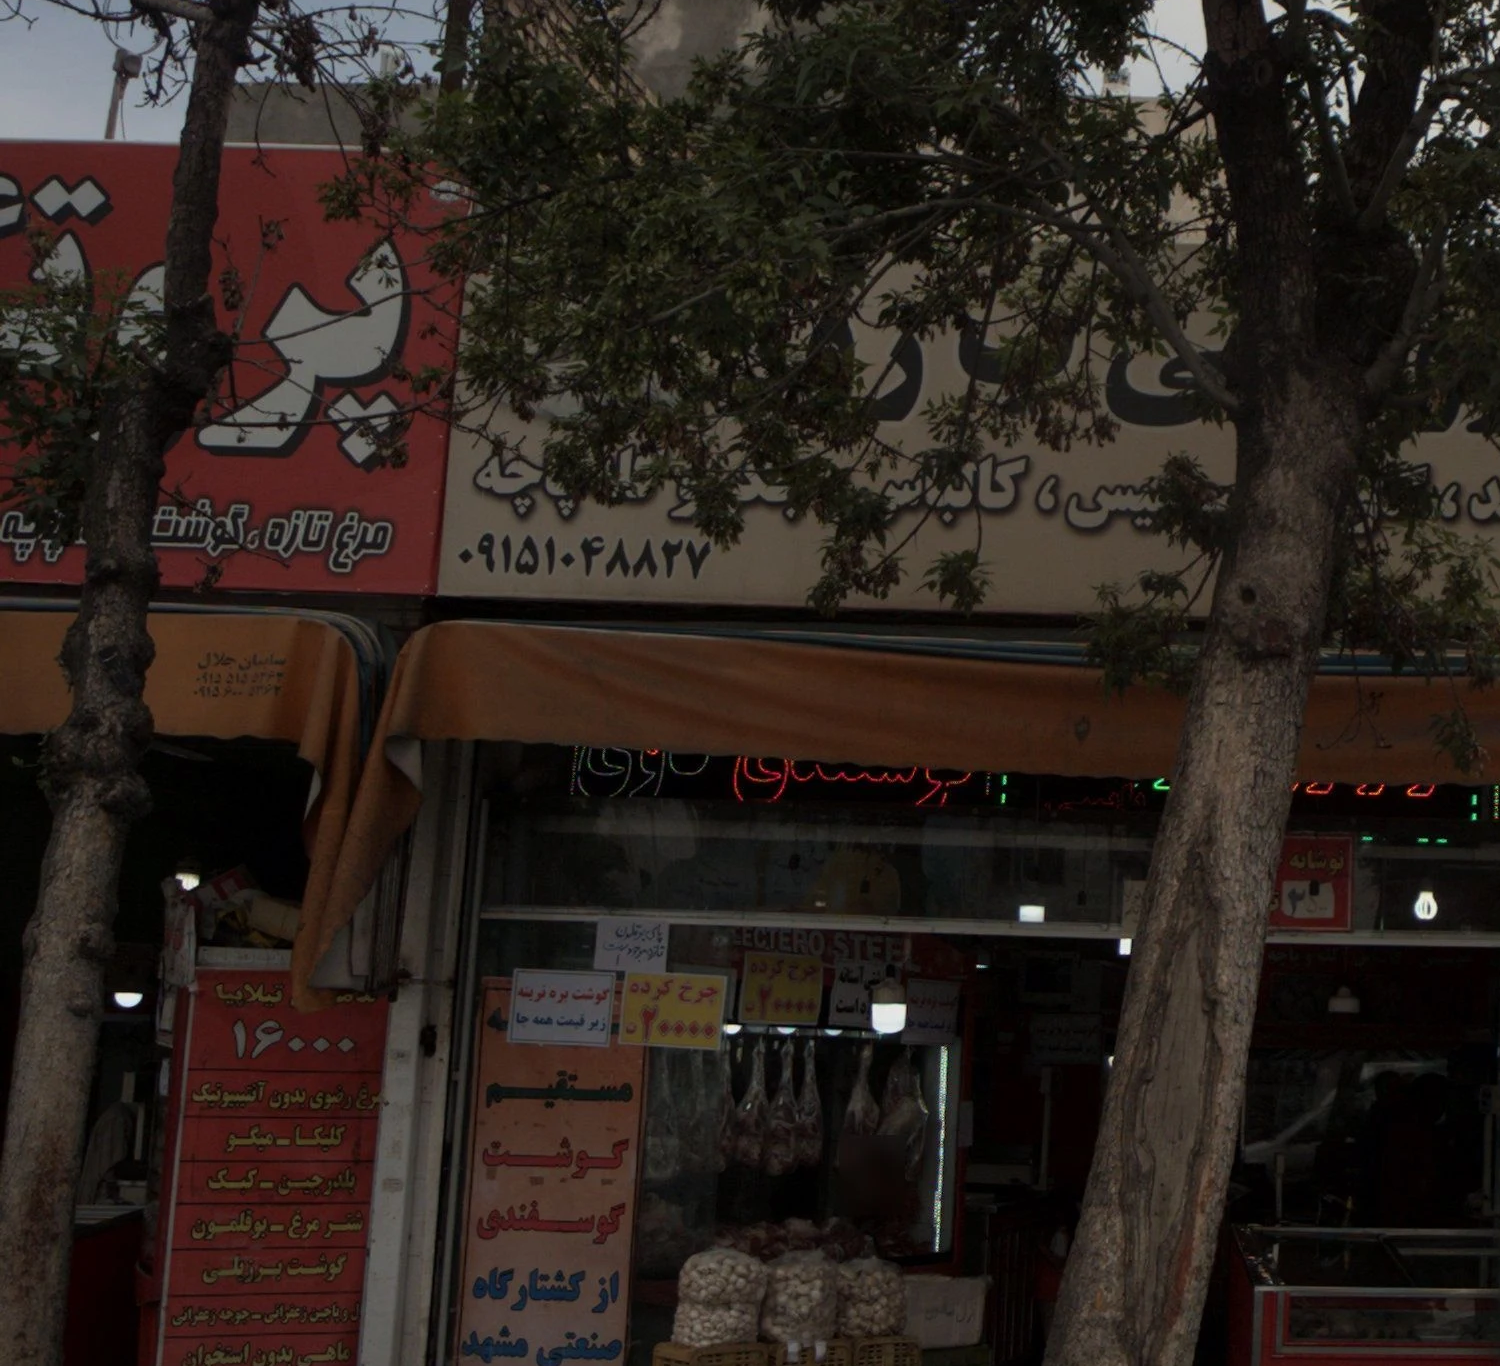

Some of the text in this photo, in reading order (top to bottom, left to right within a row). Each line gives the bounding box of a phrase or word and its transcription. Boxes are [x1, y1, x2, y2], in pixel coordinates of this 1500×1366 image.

[265, 509, 333, 557] تازه
[329, 511, 393, 573] مرغ
[459, 532, 711, 579] ۰۹۱۵۱۰۴۸۸۲۷
[1288, 850, 1345, 875] نوشابه
[215, 982, 285, 1008] تیلاپیا
[550, 989, 569, 1003] بره
[572, 988, 610, 1006] گوشت
[629, 978, 718, 1003] چرخ کرده
[515, 1011, 529, 1026] جا
[532, 1014, 554, 1028] همه
[556, 1014, 586, 1029] قیمت
[588, 1014, 608, 1033] زیر
[638, 1004, 718, 1042] ۲۰۰۰۰
[232, 1018, 355, 1060] ۱۶۰۰۰
[268, 1086, 307, 1111] بدون
[308, 1084, 353, 1112] رضوی
[485, 1069, 634, 1110] مستقیم
[224, 1123, 274, 1154] میگو
[481, 1136, 630, 1179] گوشت
[206, 1166, 358, 1197] بلدرچین کبک
[190, 1208, 365, 1241] شتر مرغ بوقلمون
[476, 1200, 627, 1245] گوسفندی
[202, 1251, 349, 1284] گوشت برزیلی
[472, 1267, 620, 1314] از کشتارگاه
[170, 1306, 218, 1328] زعفرانی
[218, 1307, 250, 1326] جوجه
[263, 1302, 310, 1325] زعفرانی
[461, 1325, 529, 1364] مشهد
